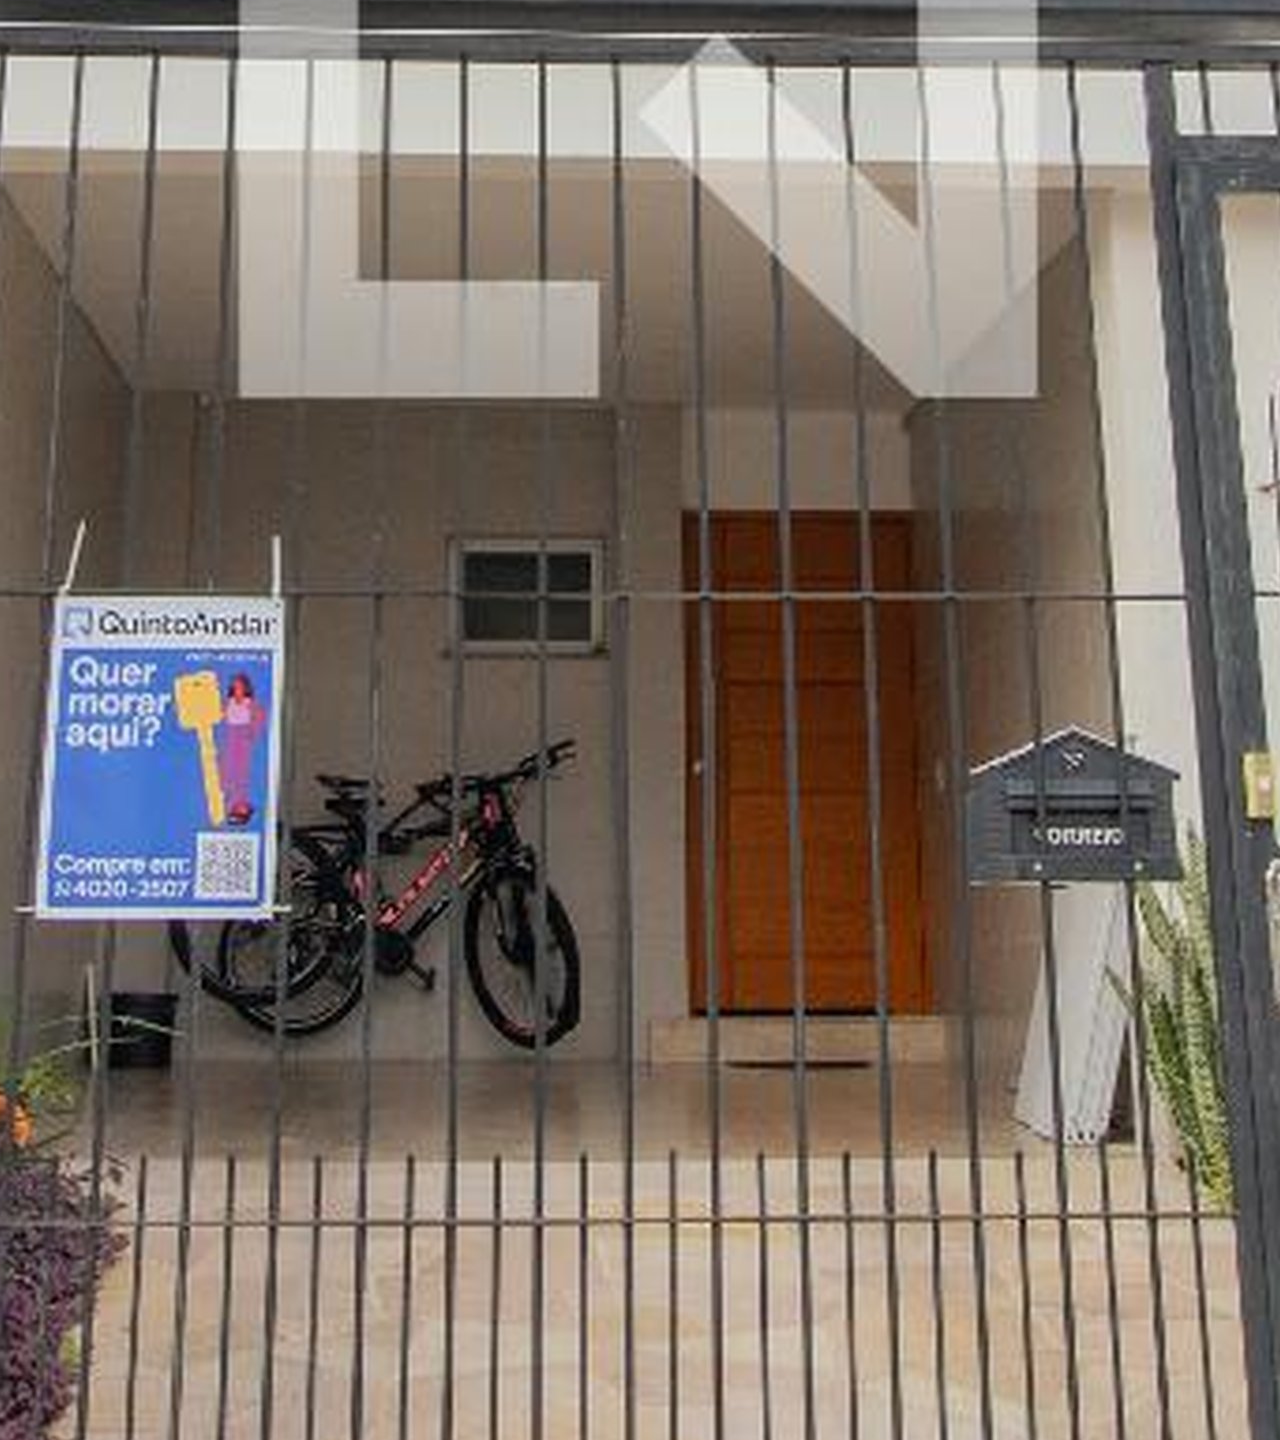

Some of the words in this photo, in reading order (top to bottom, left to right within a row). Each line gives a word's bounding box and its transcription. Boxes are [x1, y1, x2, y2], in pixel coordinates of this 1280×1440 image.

[99, 609, 278, 637] QuintoAndar
[70, 655, 158, 688] Quer
[68, 692, 171, 716] morar
[66, 716, 162, 753] aqui?
[54, 853, 146, 878] Compre
